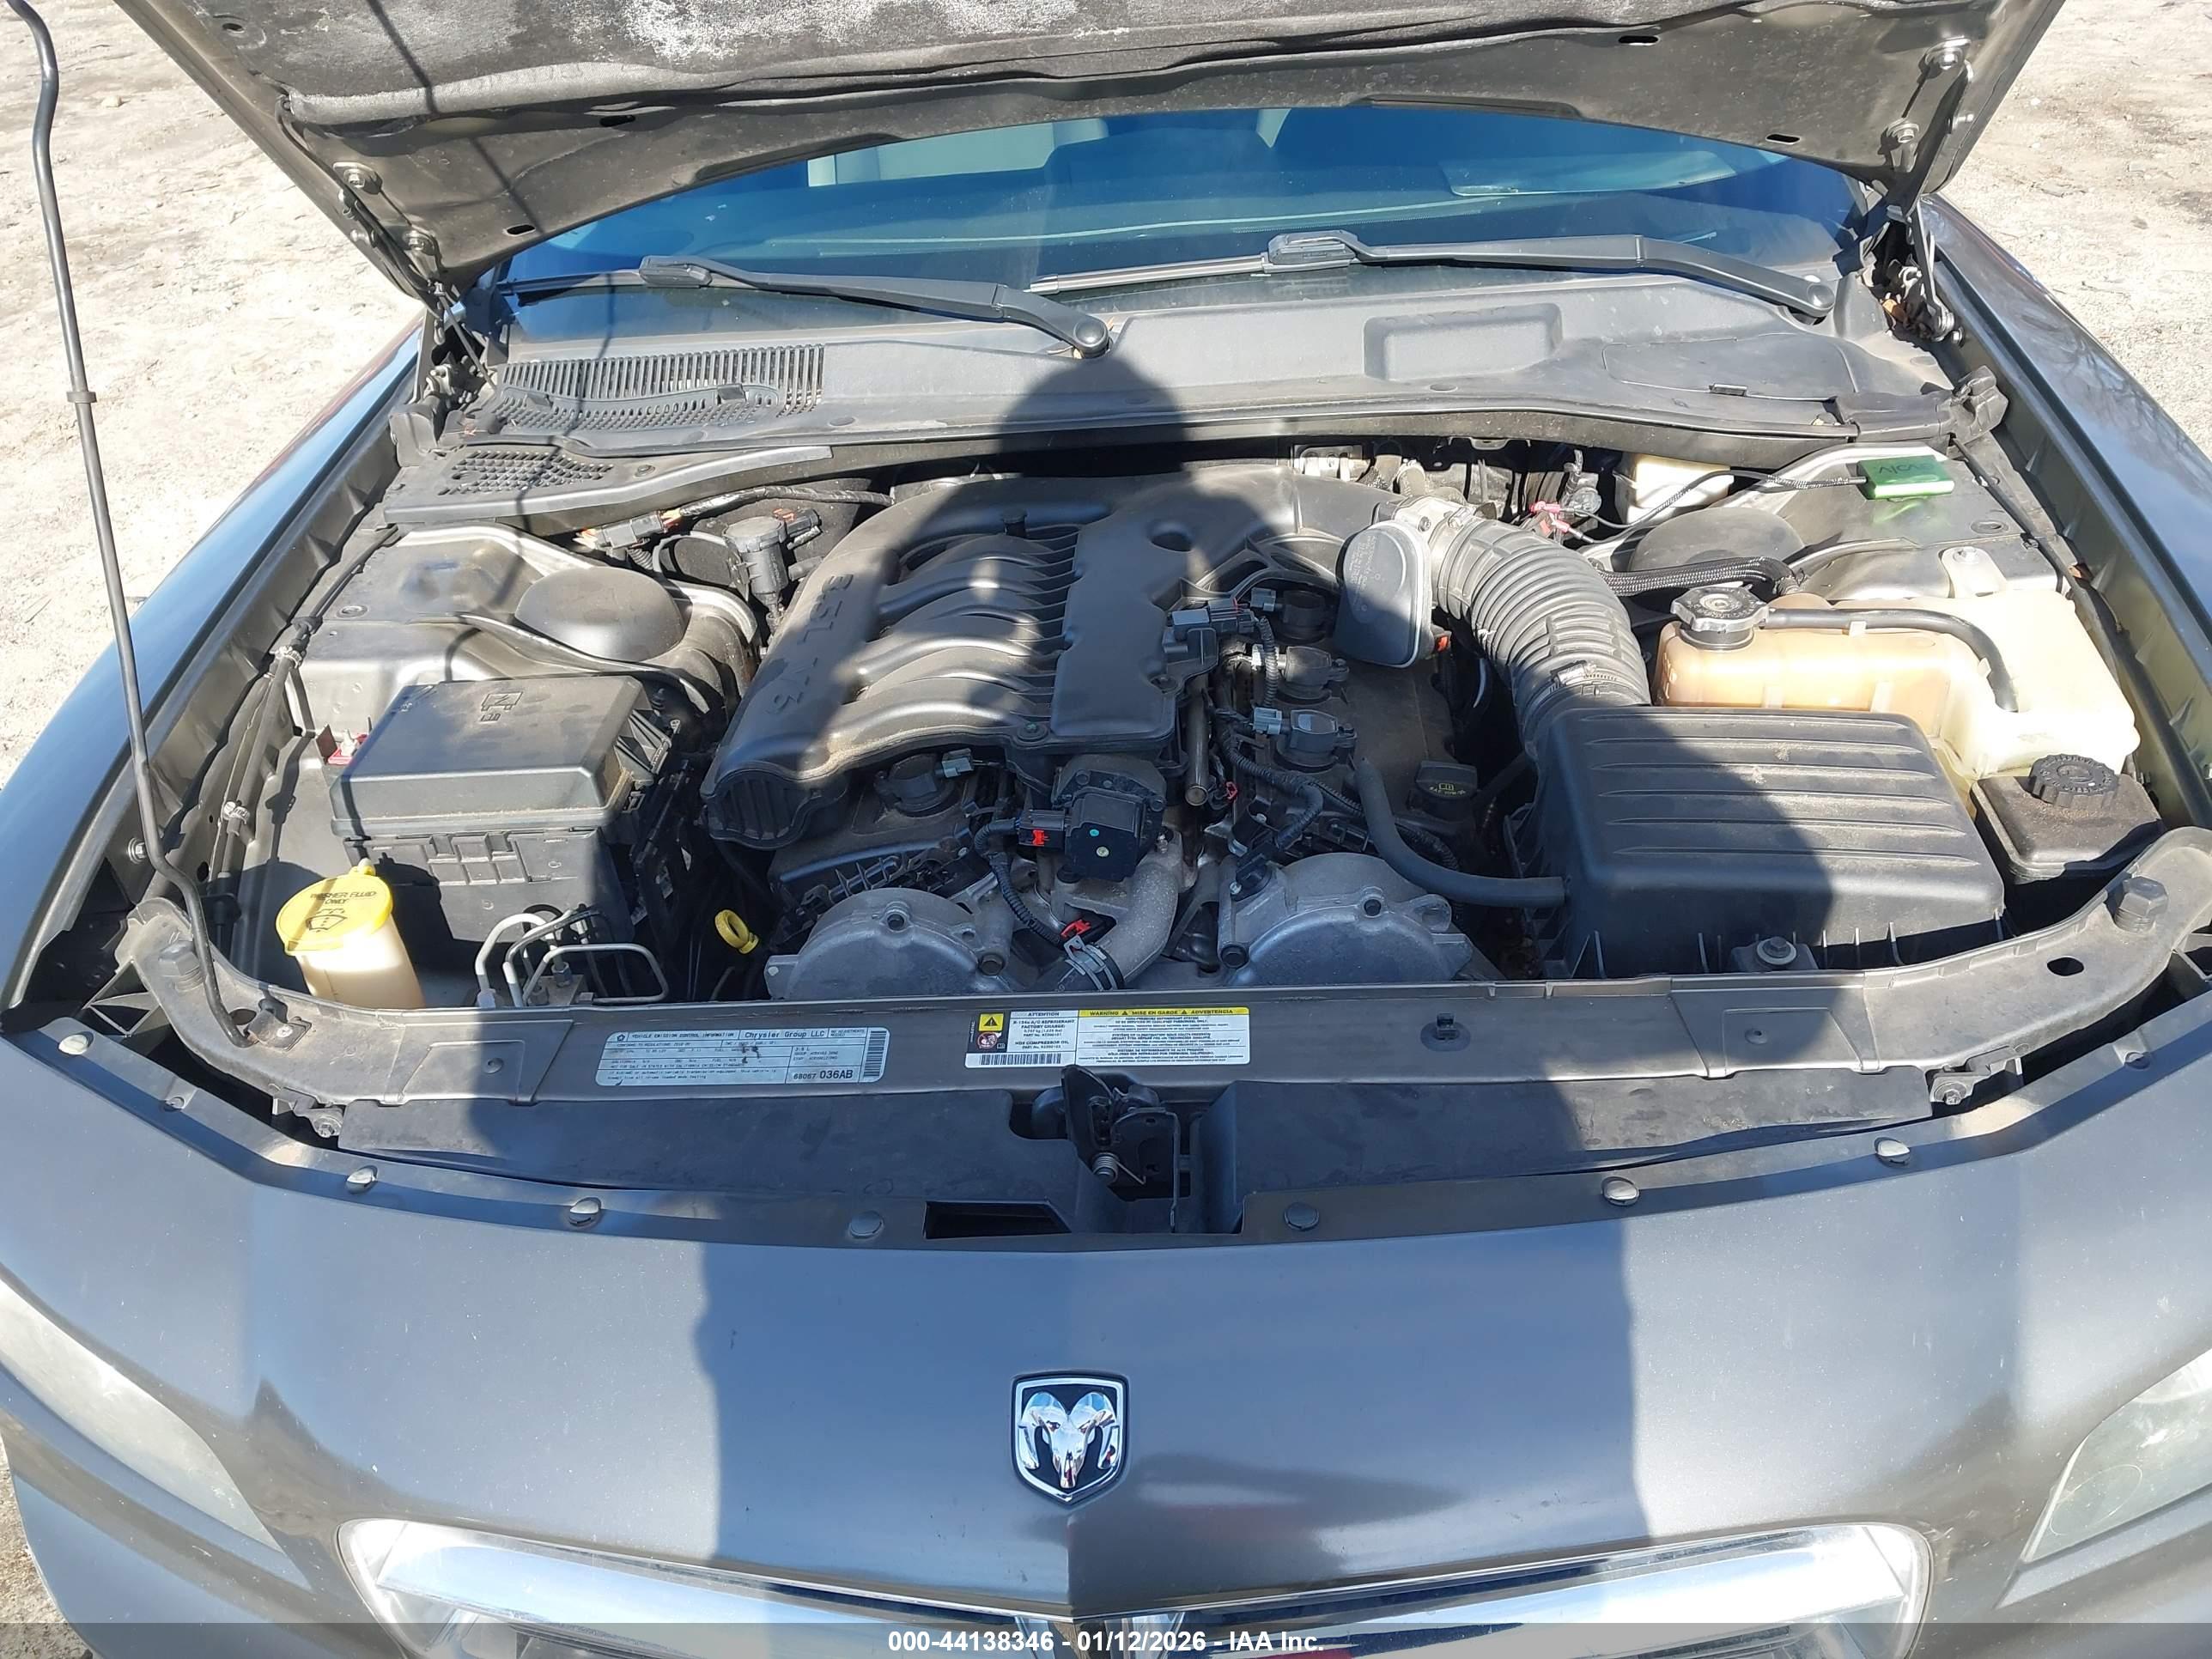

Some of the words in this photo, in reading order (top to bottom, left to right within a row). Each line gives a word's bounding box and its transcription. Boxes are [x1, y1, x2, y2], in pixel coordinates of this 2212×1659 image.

[744, 1031, 780, 1040] Chrysler
[784, 1030, 807, 1040] Group
[819, 1069, 854, 1079] 036AB
